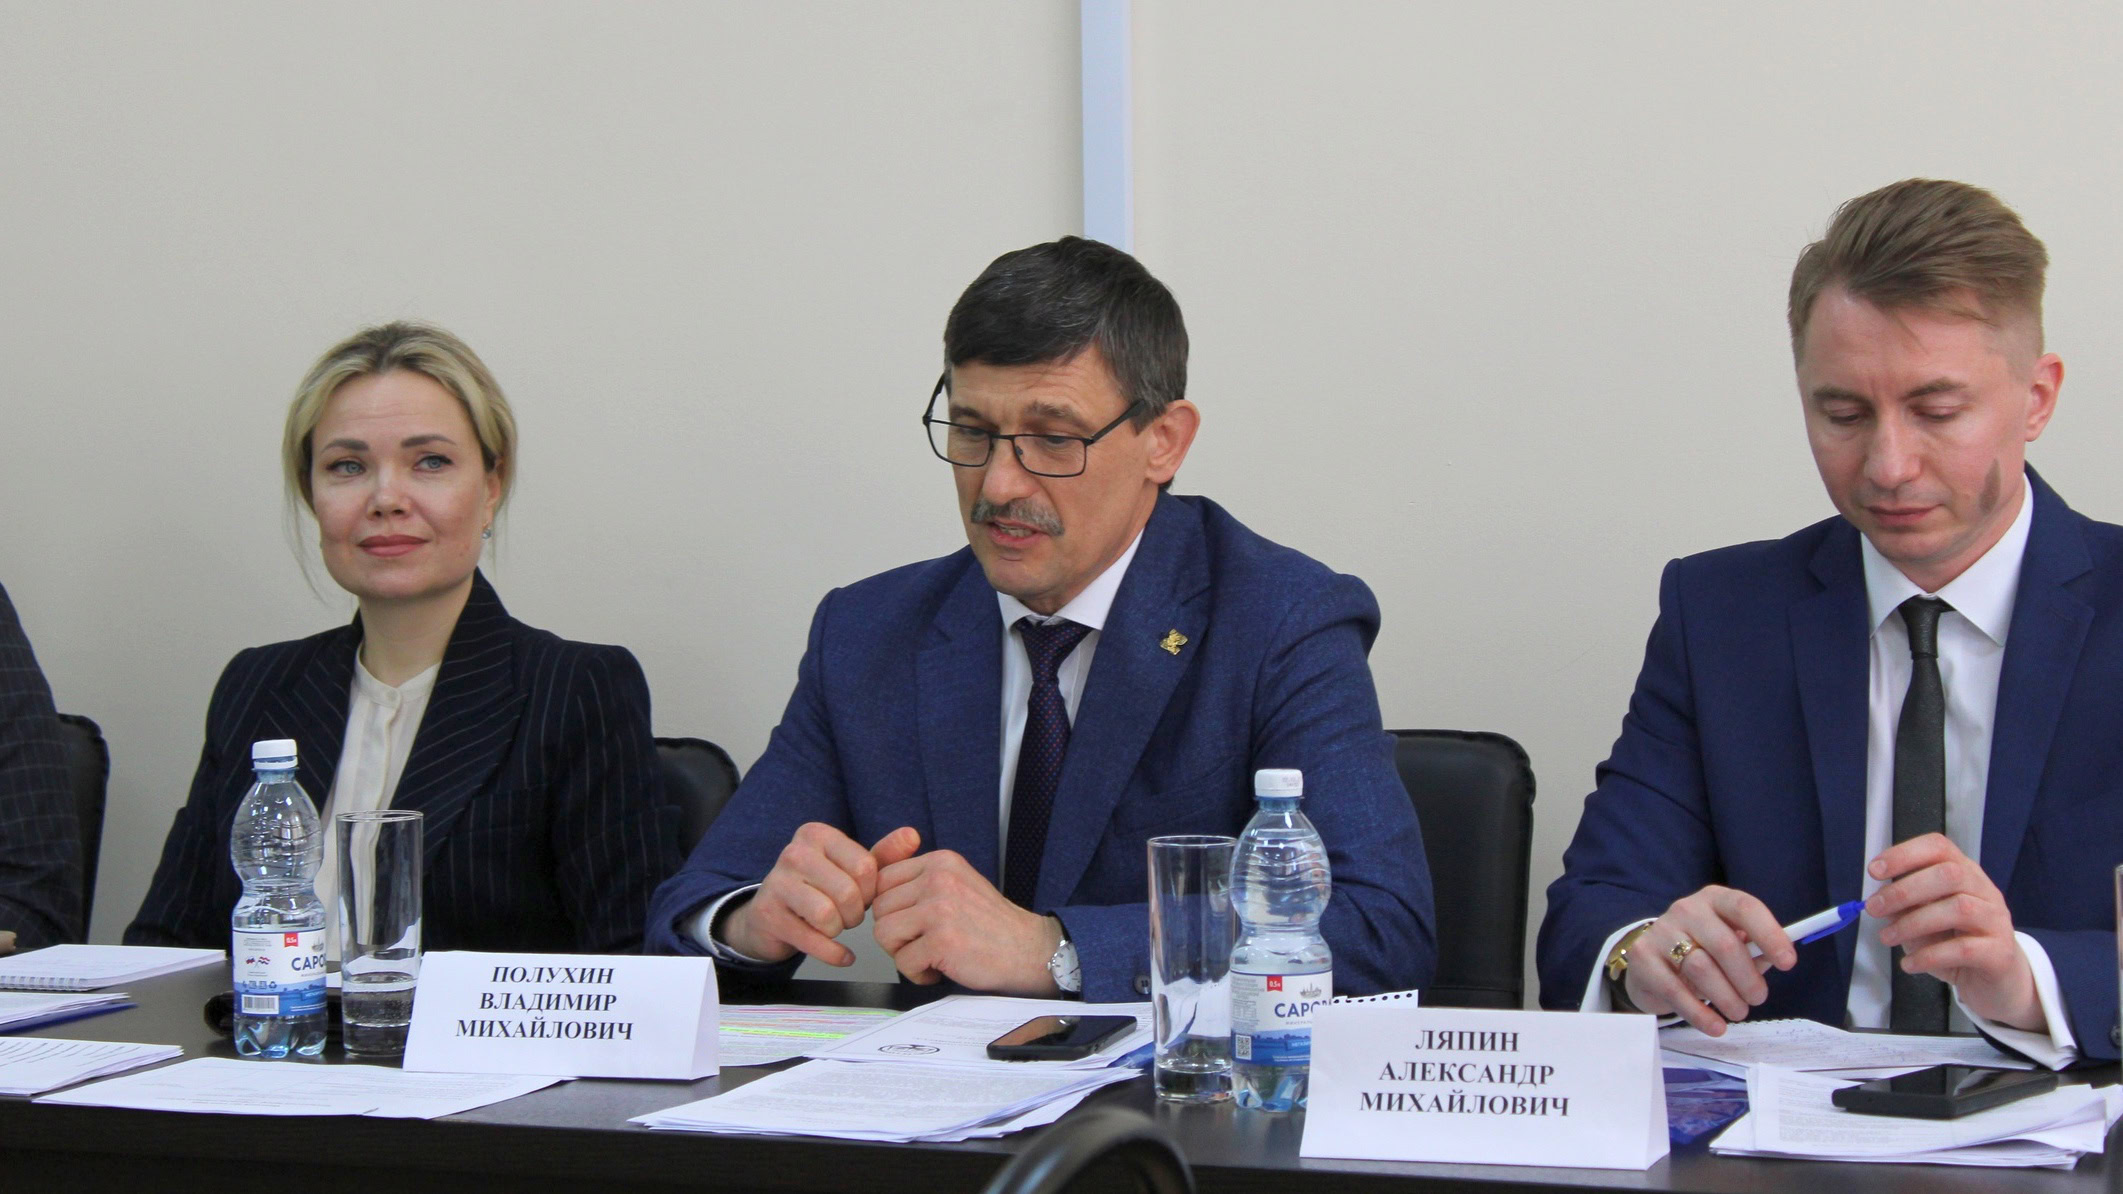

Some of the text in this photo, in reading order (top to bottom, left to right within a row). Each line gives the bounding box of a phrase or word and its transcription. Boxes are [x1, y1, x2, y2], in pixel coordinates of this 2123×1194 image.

[291, 953, 327, 972] САРО
[491, 965, 615, 984] ПОЛУХИН
[479, 992, 617, 1014] ВЛАДИМИР
[455, 1016, 634, 1041] МИХАЙЛОВИЧ
[1415, 1029, 1521, 1052] ЛЯПИН
[1378, 1061, 1556, 1088] АЛЕКСАНДР
[1359, 1089, 1571, 1117] МИХАЙЛОВИЧ
